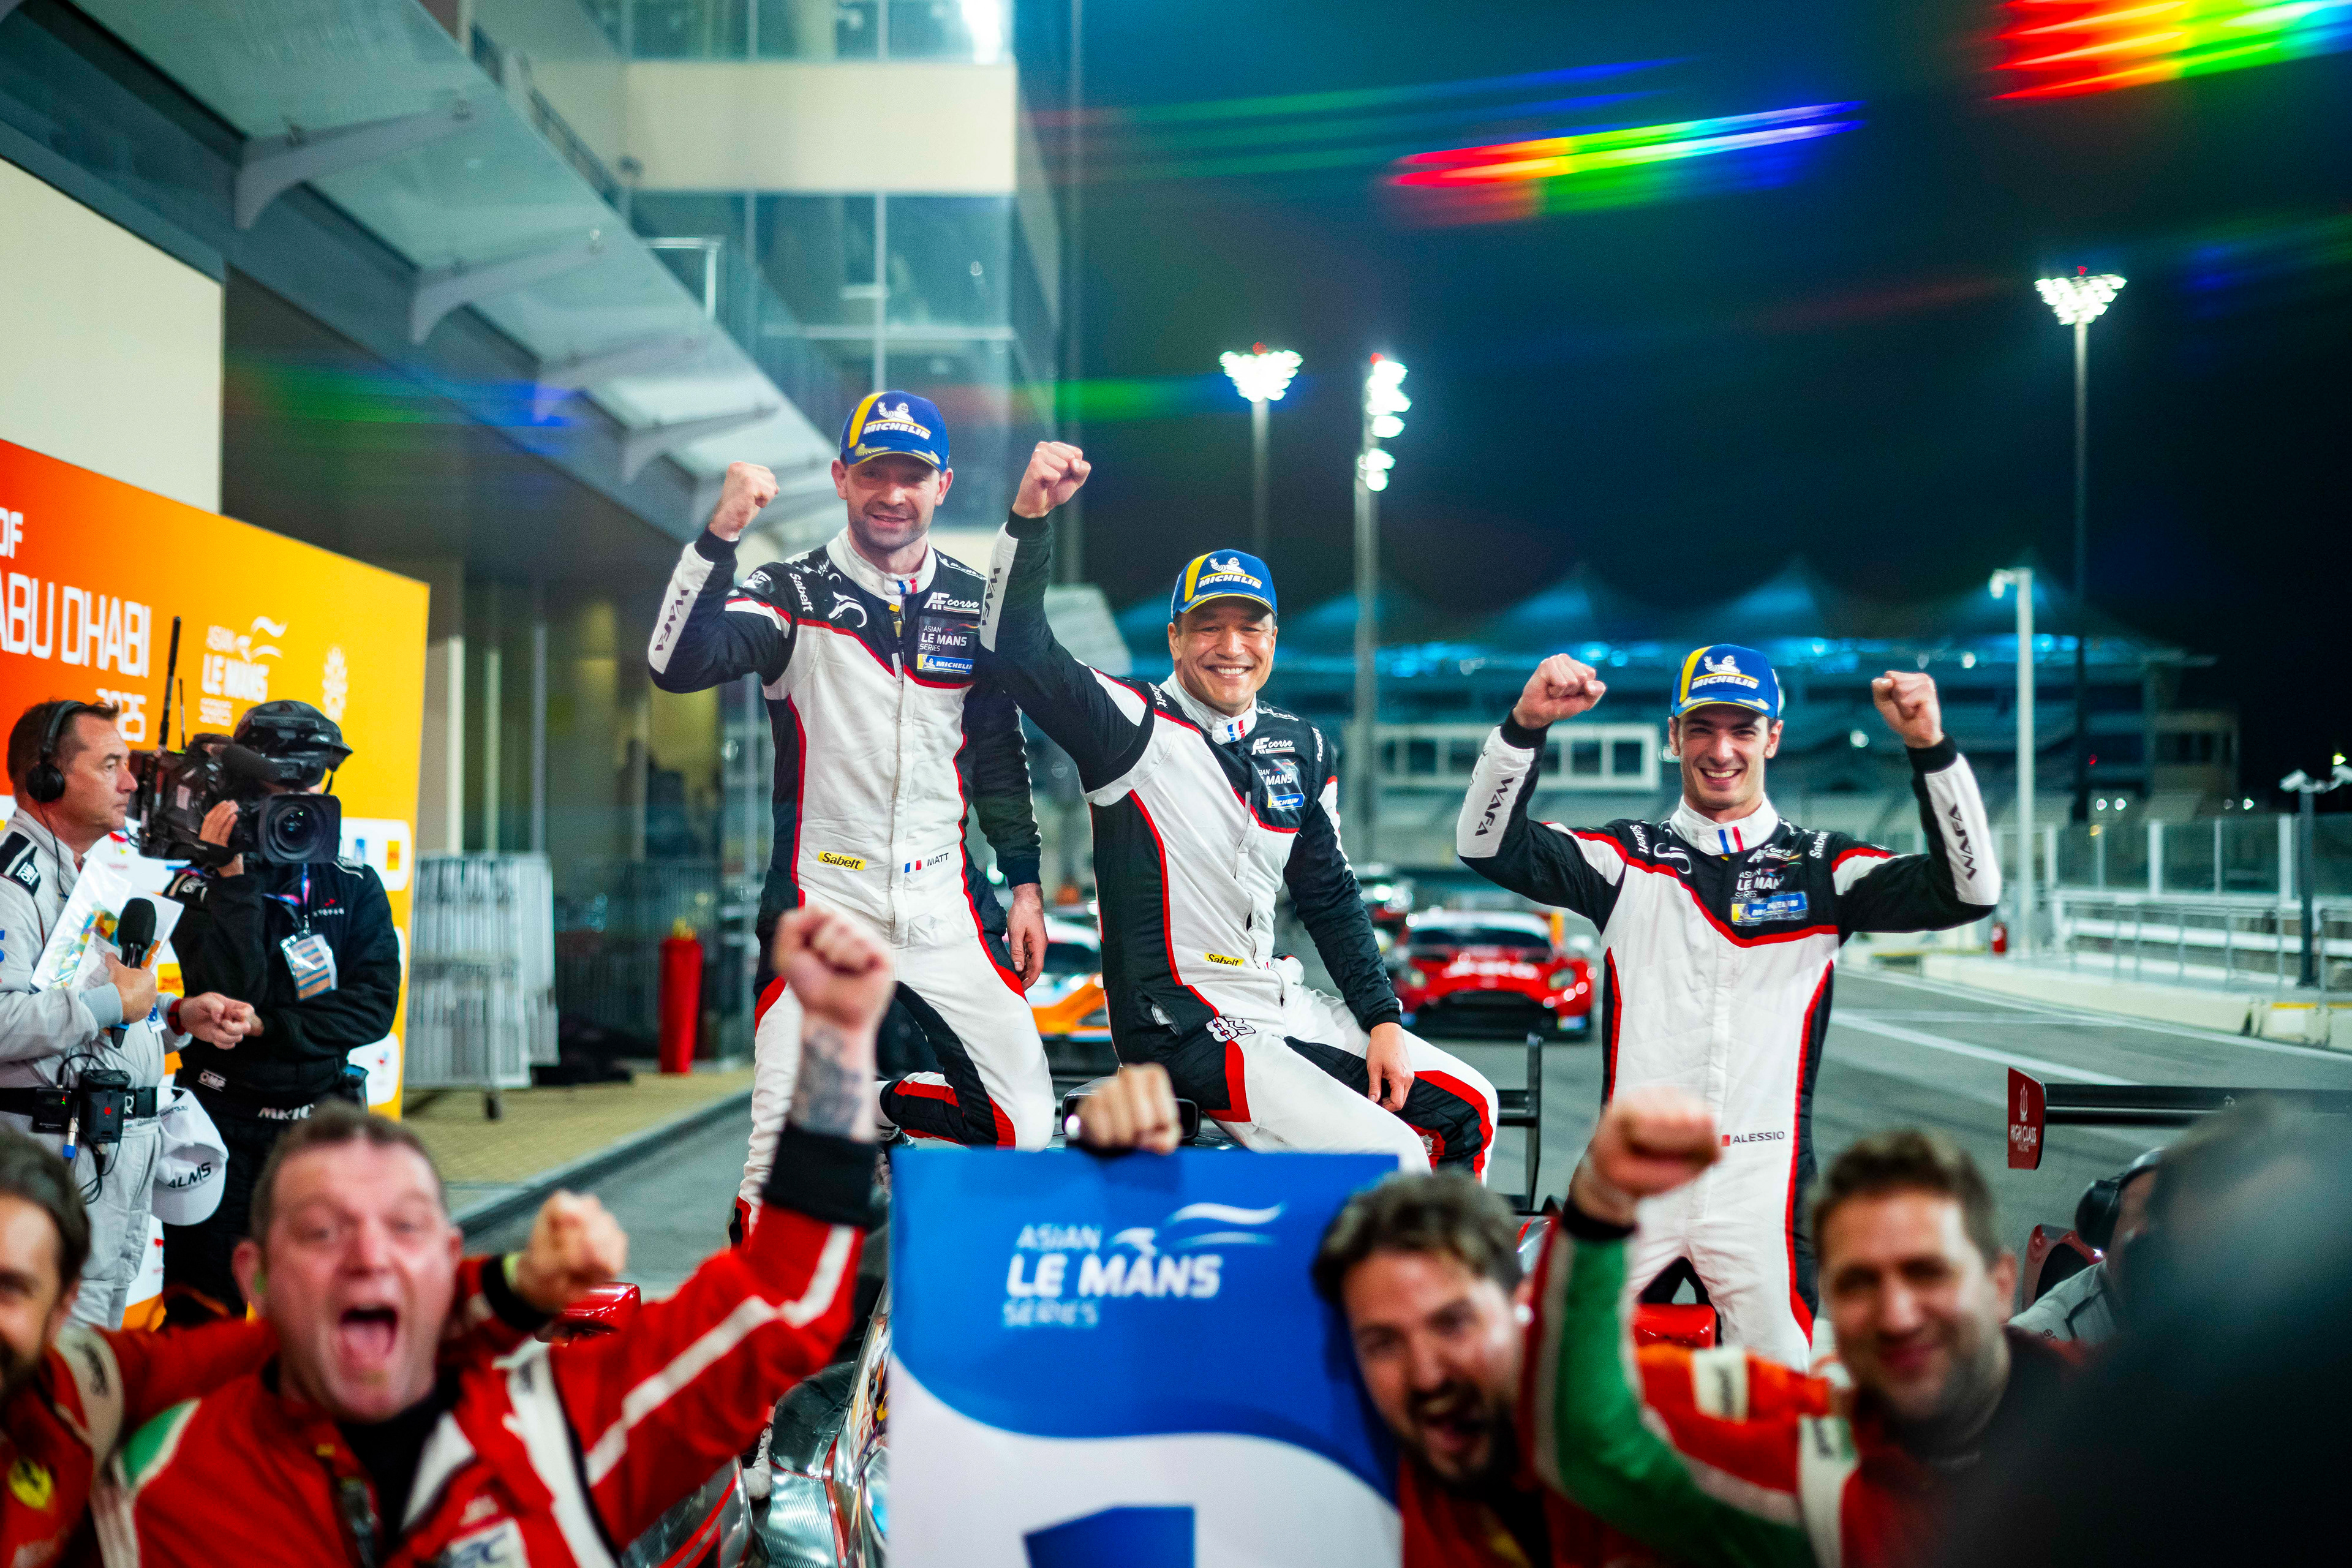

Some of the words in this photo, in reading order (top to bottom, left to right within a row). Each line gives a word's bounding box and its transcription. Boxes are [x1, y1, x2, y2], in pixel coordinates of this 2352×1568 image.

[863, 423, 930, 440] MICHELIN
[0, 506, 23, 559] OF
[1198, 575, 1262, 589] MICHELIN
[790, 573, 813, 613] Sabelt
[948, 599, 979, 608] corse
[61, 586, 151, 679] DHABI
[921, 633, 934, 643] LE
[937, 635, 967, 646] MANS
[936, 661, 973, 671] MICHELIN
[202, 653, 224, 696] LE
[1691, 676, 1758, 690] MICHELIN
[1148, 682, 1167, 708] abelt
[1268, 740, 1293, 748] corse
[1266, 774, 1292, 786] MANS
[1475, 777, 1514, 836] WAFA
[1949, 804, 1977, 880] WAFA
[822, 853, 861, 869] Sabelt
[927, 853, 949, 866] MATT
[1737, 879, 1752, 891] LE
[1754, 876, 1784, 889] MAN
[1207, 954, 1239, 966] Sabelt
[1732, 1131, 1785, 1144] ALESSIO
[1006, 1253, 1068, 1298] LE
[1077, 1253, 1224, 1298] MANS
